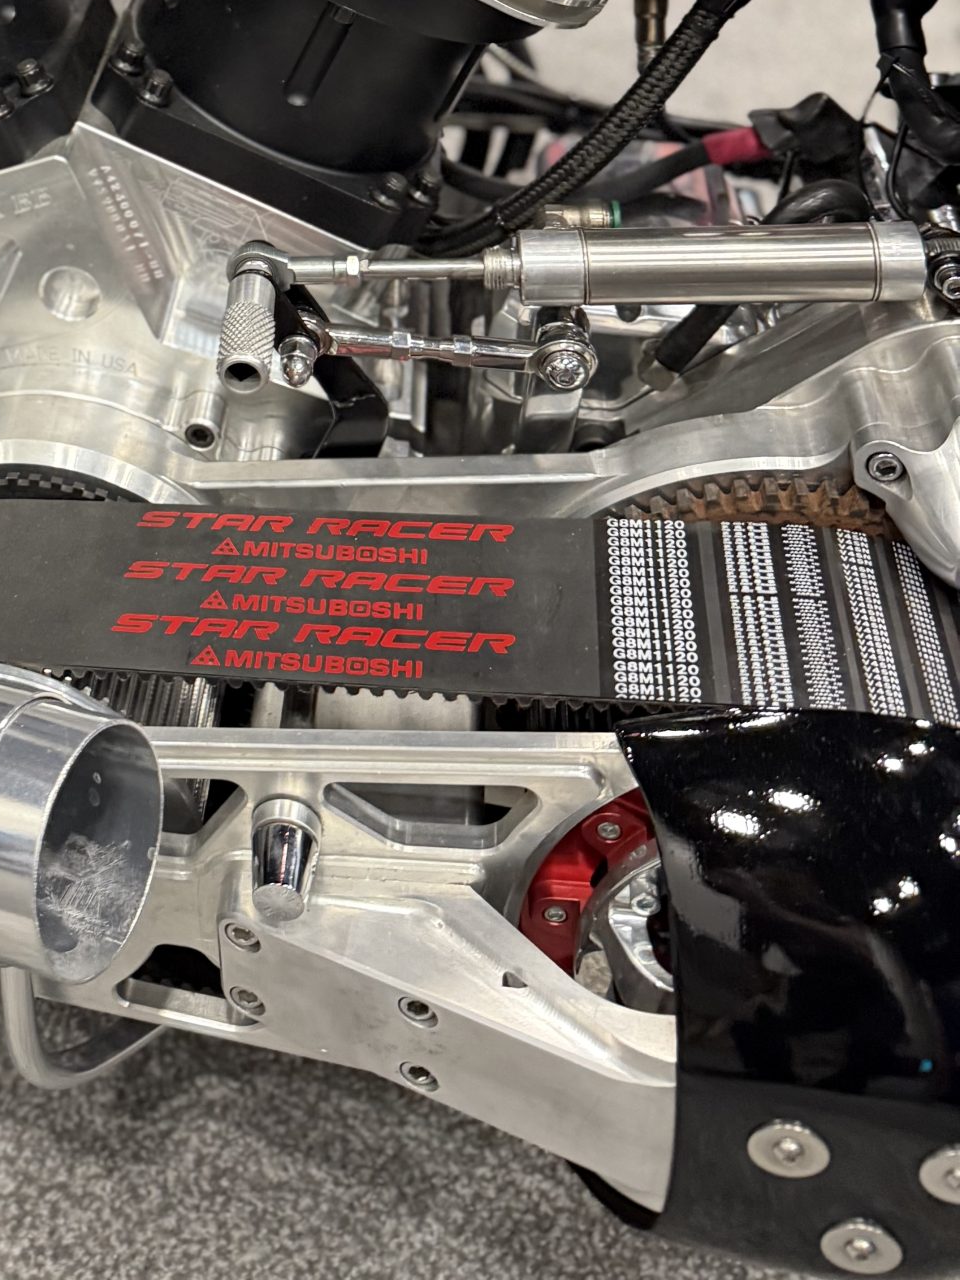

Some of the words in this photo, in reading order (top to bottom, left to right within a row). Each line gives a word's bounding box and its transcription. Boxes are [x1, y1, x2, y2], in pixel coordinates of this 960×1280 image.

[72, 347, 91, 364] IN
[101, 353, 139, 377] USA
[136, 511, 294, 534] STAR
[306, 517, 515, 543] RACER
[607, 528, 685, 539] G8M1120
[608, 537, 686, 548] G8M1120
[242, 540, 429, 565] MITSUBOSHI
[608, 547, 687, 557] G8M1120
[609, 556, 688, 567] G8M1120
[609, 566, 689, 578] G8M1120
[123, 561, 287, 586] STAR
[300, 569, 516, 598] RACER
[609, 575, 690, 587] G8M1120
[610, 585, 691, 597] G8M1120
[232, 593, 423, 620] MITSUBOSHI
[611, 595, 692, 608] G8M1120
[611, 606, 693, 618] G8M1120
[612, 616, 694, 629] G8M1120
[111, 613, 280, 641] STAR
[294, 623, 517, 655] RACER
[612, 626, 696, 640] G8M1120
[612, 637, 697, 651] G8M1120
[613, 648, 698, 662] G8M1120
[224, 649, 423, 679] MITSUBOSHI
[614, 660, 699, 675] G8M1120
[614, 672, 700, 686] G8M1120
[615, 683, 701, 698] G8M1120
